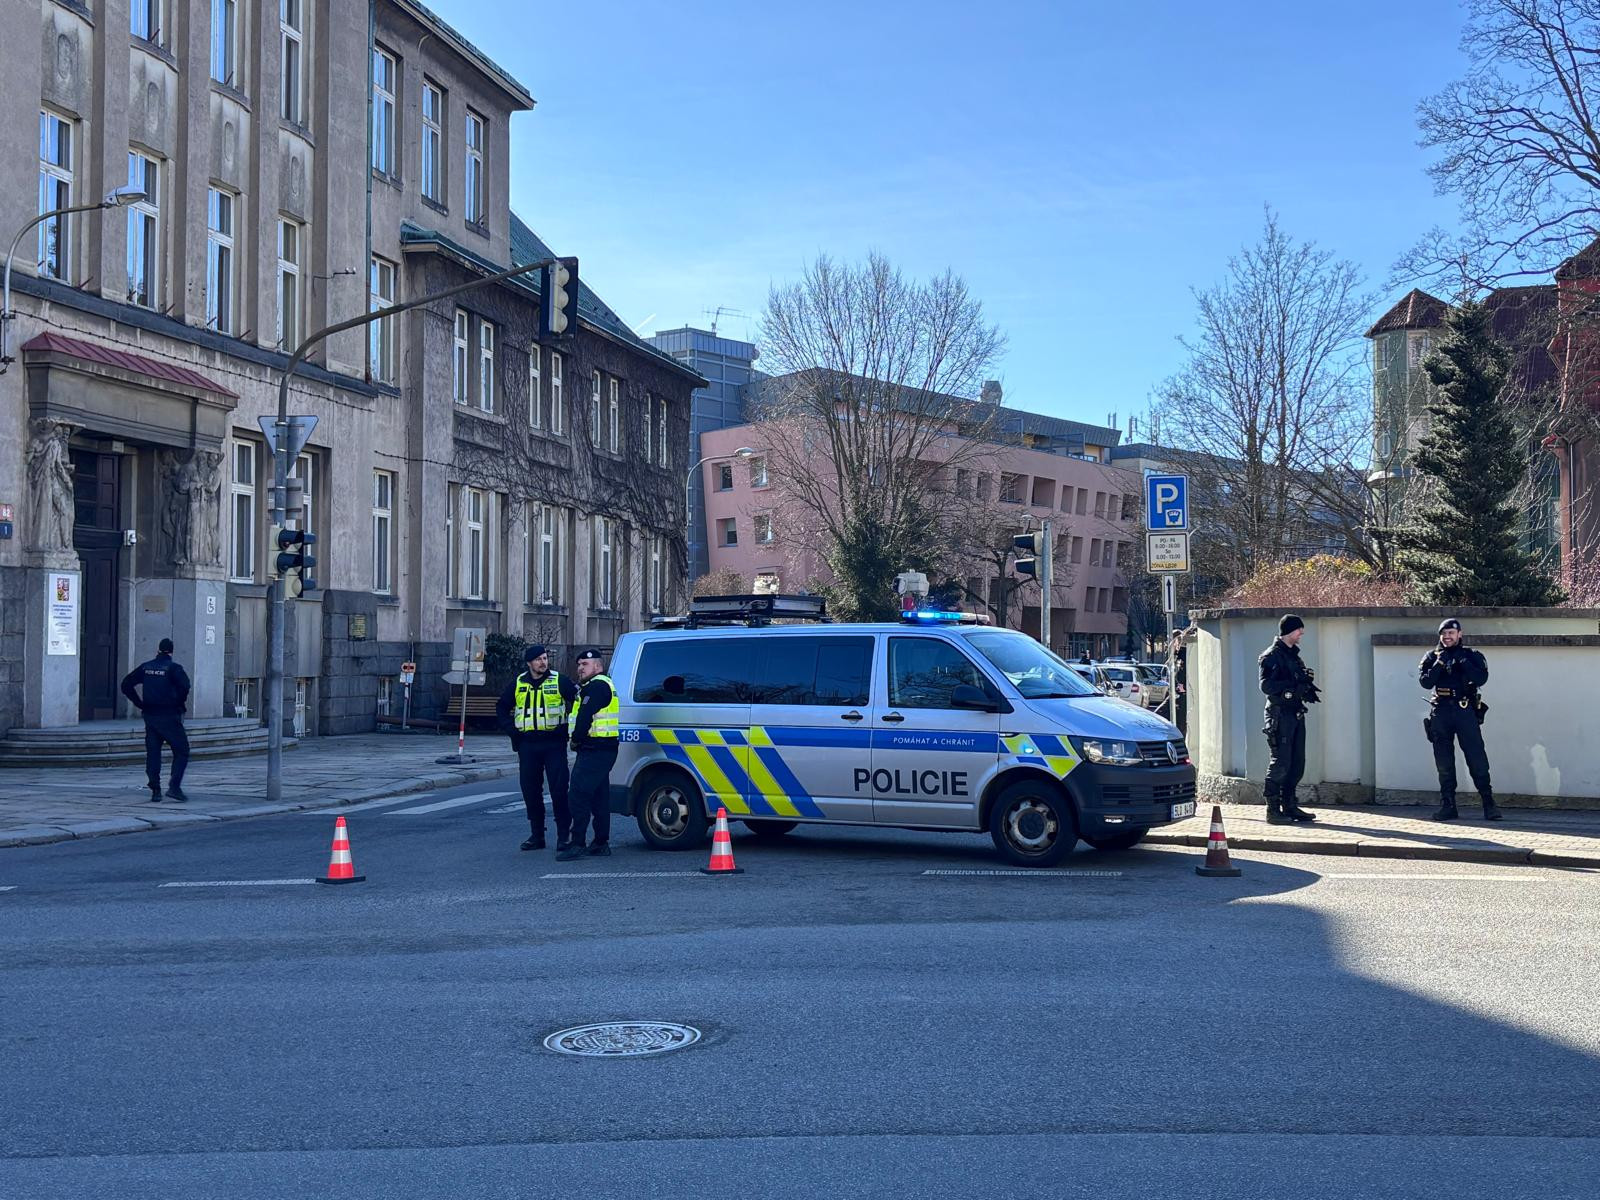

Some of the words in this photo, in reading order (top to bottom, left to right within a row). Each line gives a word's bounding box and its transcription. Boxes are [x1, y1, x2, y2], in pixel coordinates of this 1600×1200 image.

[1156, 484, 1178, 513] P
[621, 730, 640, 741] 158
[893, 736, 930, 744] POMÁHAT
[941, 737, 975, 746] CHRÁNIT
[853, 768, 969, 796] POLICIE
